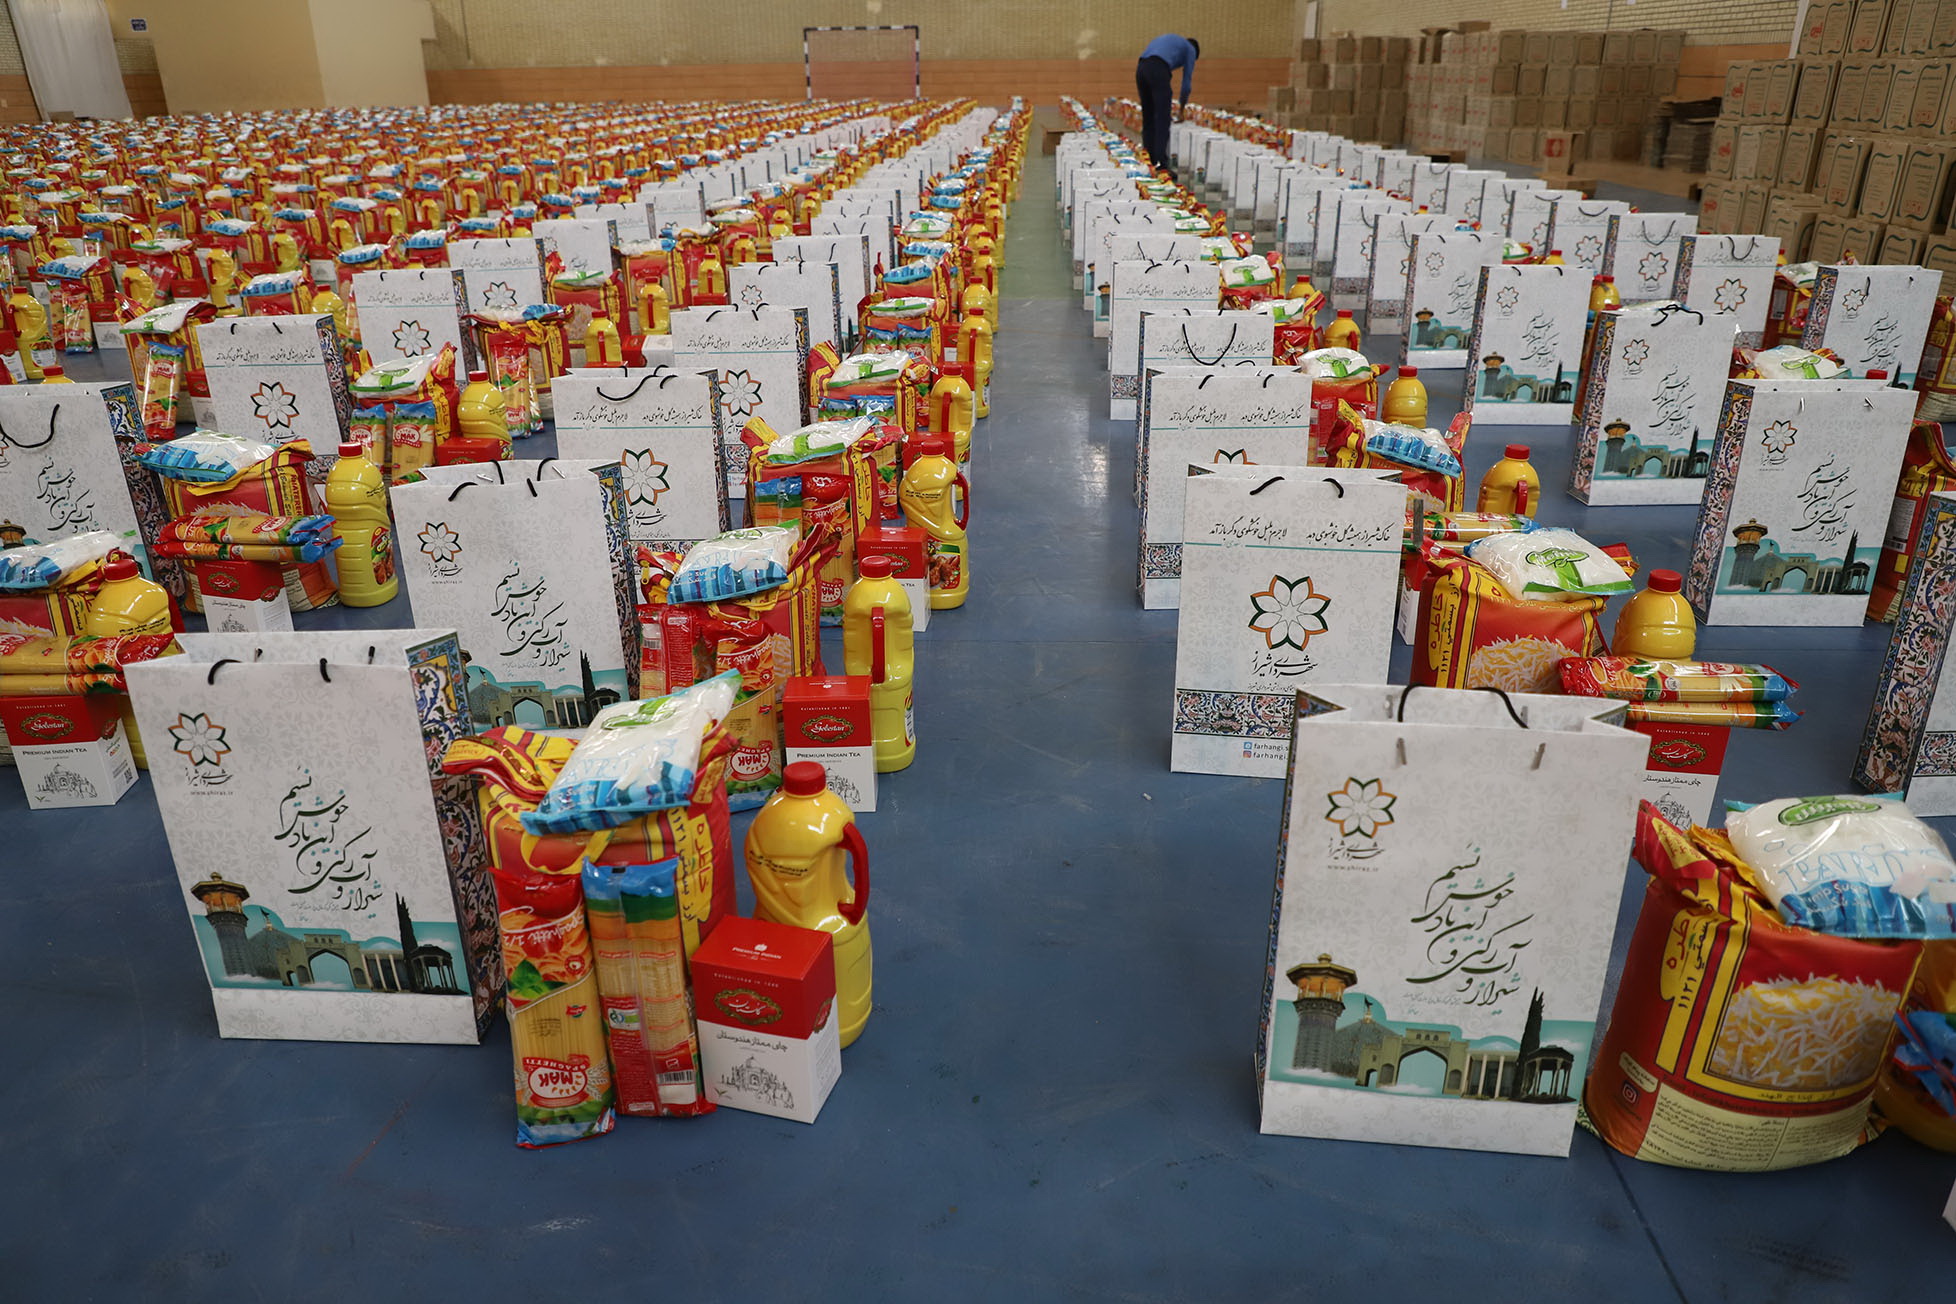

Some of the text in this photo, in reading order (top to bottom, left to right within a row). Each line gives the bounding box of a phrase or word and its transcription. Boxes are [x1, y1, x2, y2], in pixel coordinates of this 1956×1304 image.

[1209, 516, 1287, 545] لاجرم بلبل خوشگوی دگر باز آمد
[1306, 522, 1395, 546] خاک شیراز همیشه گل خوشبوی دهد
[491, 577, 547, 616] خوش
[495, 561, 520, 609] نسیم
[500, 601, 564, 655] رکنی
[501, 602, 536, 643] این باد
[530, 619, 568, 643] آب
[1430, 593, 1443, 650] خاطره
[540, 643, 571, 672] شیراز
[733, 639, 773, 665] Spaghetti
[1252, 650, 1318, 678] شهرداری شیراز
[810, 722, 845, 734] Golestan
[738, 754, 761, 766] MAK
[274, 789, 349, 840] خوش
[280, 766, 312, 832] نسیم
[288, 821, 336, 876] این باد
[288, 826, 372, 894] رکنی
[329, 849, 378, 882] آب
[1411, 871, 1515, 923] خوش
[1424, 842, 1481, 913] نسیم
[341, 880, 383, 919] شیراز
[527, 910, 585, 946] Spaghetti
[1424, 905, 1488, 965] این باد
[1405, 913, 1535, 984] رکنی
[1460, 938, 1533, 974] آب
[1463, 972, 1521, 1016] شیراز
[525, 1058, 587, 1073] SPAGHETTI
[538, 1071, 574, 1089] MAK
